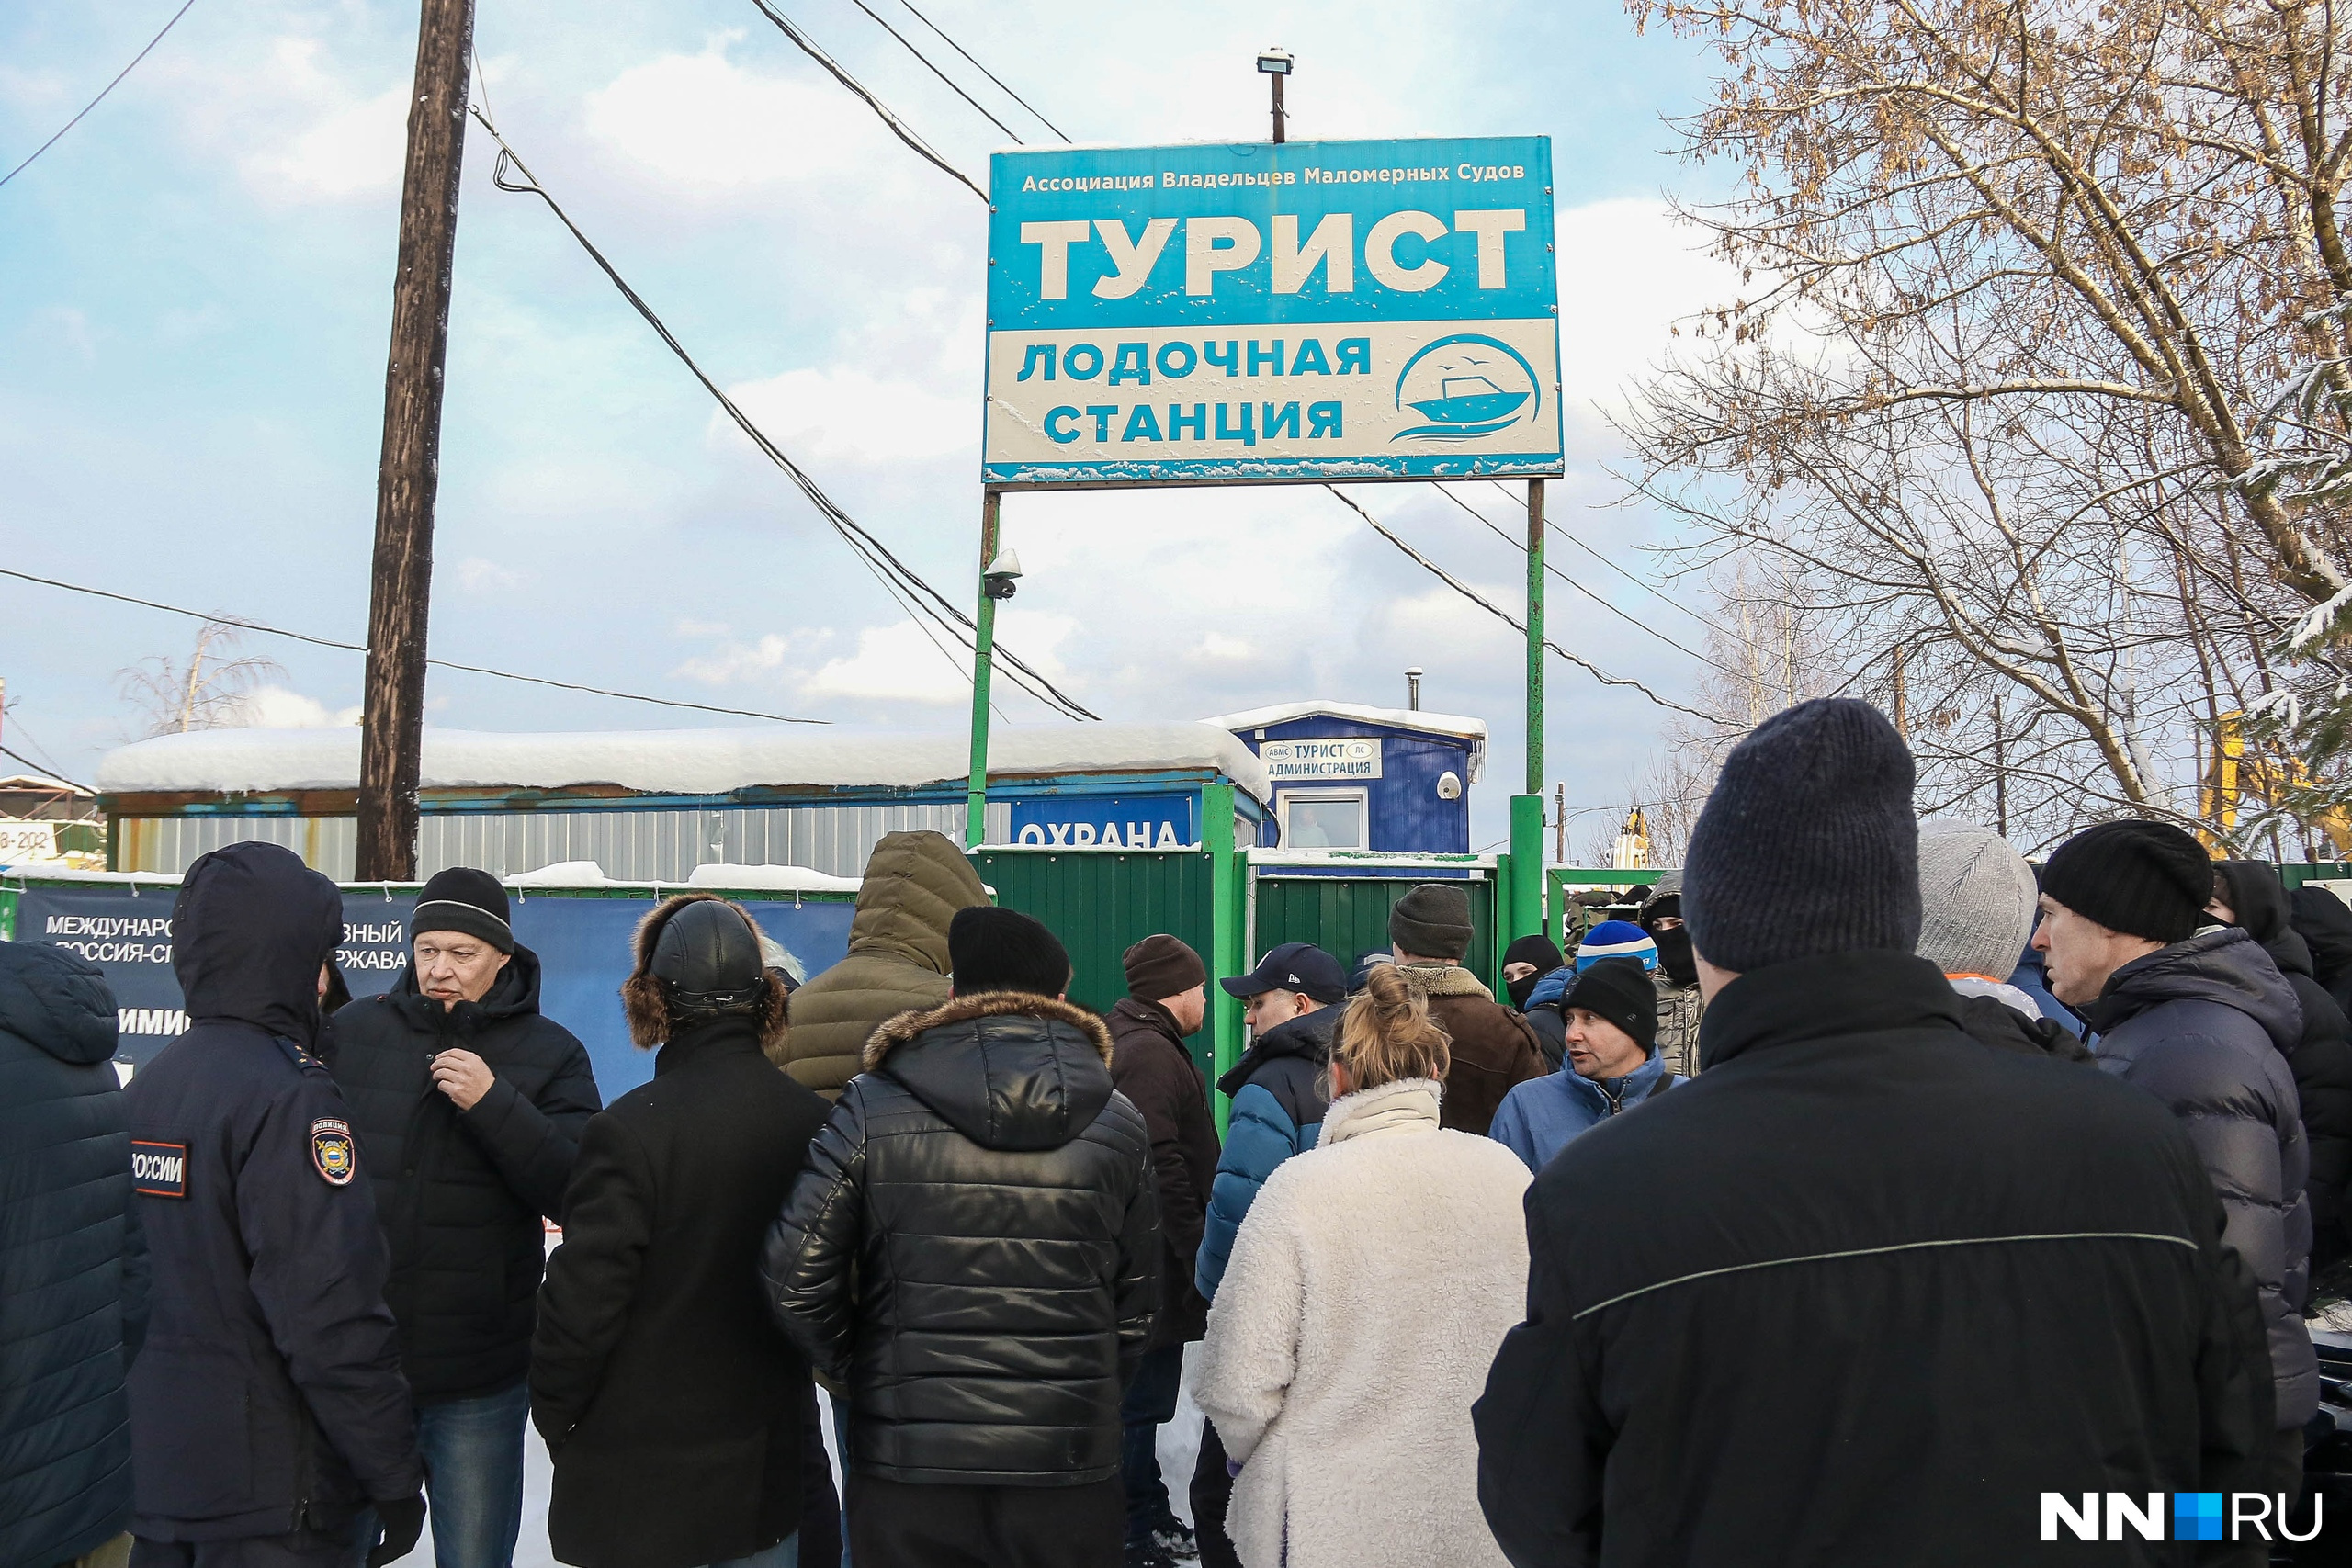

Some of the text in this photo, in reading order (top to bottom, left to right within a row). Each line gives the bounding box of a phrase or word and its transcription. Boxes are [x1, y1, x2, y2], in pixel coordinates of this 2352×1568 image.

[1022, 163, 1525, 193] Ассоциация Владельцев Маломерных Судов
[1020, 209, 1526, 300] ТУРИСТ
[1016, 337, 1371, 386] ЛОДОЧНАЯ
[1043, 400, 1343, 447] СТАНЦИЯ
[1269, 744, 1364, 759] АВМС ТУРИСТ ЛС
[1268, 761, 1371, 777] АДМИНИСТРАЦИЯ
[1018, 821, 1180, 849] ОХРАНА
[313, 1122, 348, 1132] ПОЛИЦИЯ
